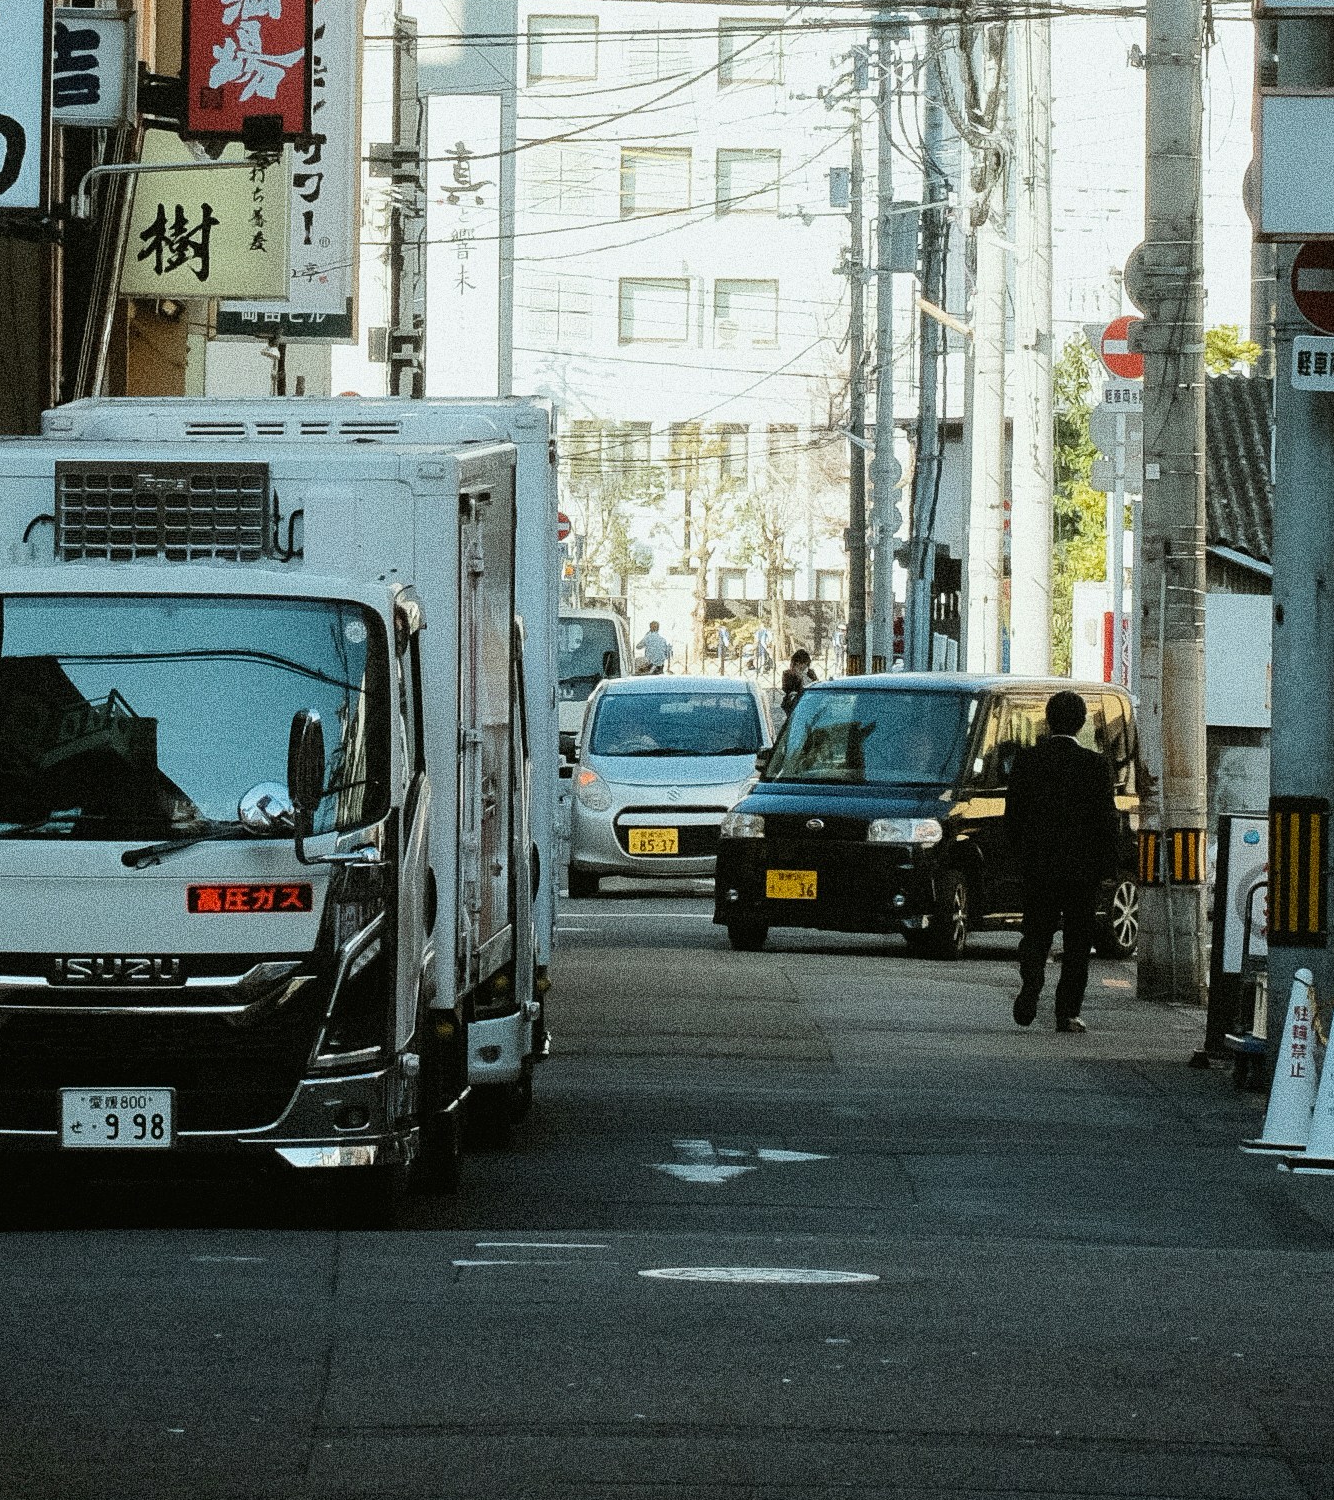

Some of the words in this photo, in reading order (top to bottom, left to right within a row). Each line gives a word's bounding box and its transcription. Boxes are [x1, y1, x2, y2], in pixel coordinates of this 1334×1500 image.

[137, 202, 221, 283] 樹
[196, 886, 305, 912] 高圧ガス
[55, 957, 182, 981] ISUZU
